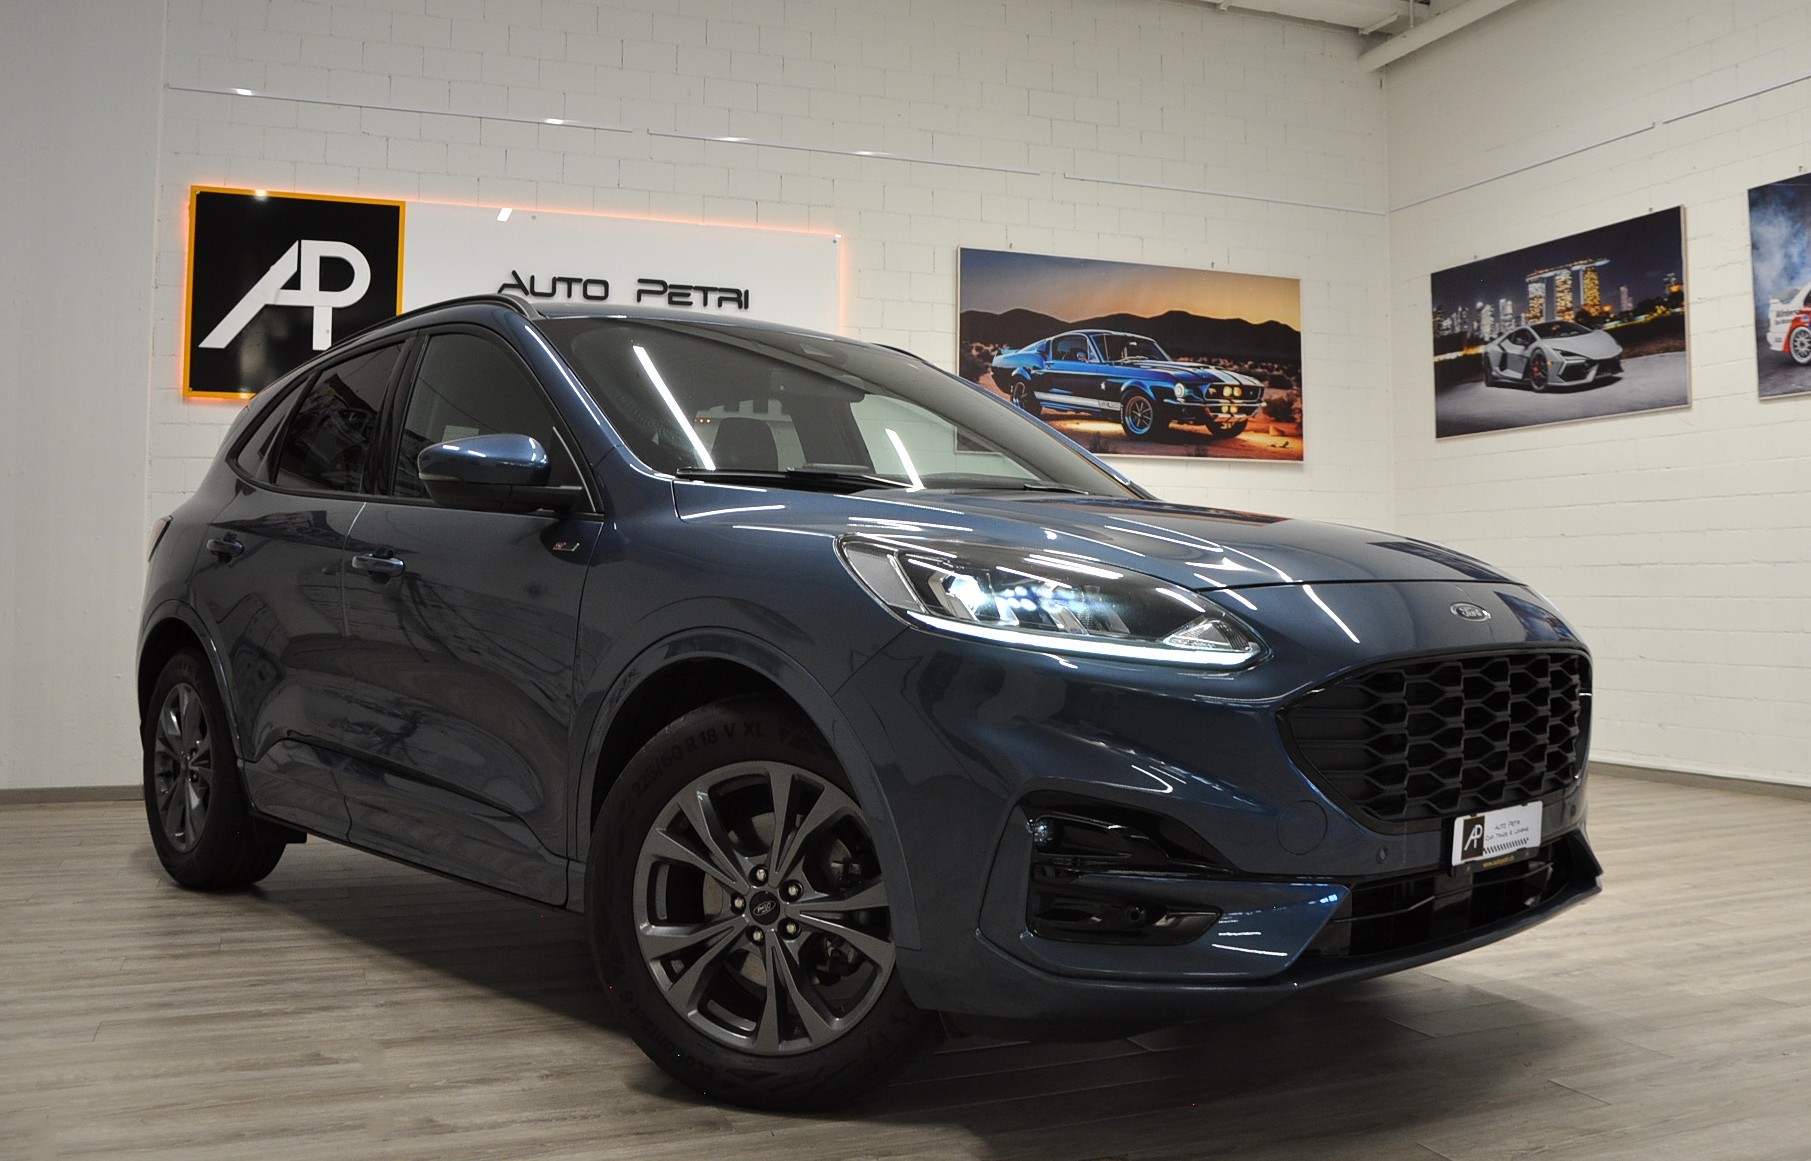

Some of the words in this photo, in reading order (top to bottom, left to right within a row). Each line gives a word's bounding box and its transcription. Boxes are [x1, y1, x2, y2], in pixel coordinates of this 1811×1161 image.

[497, 269, 610, 301] AUTO
[636, 277, 750, 310] PETRI
[631, 744, 684, 798] 225/60
[723, 722, 736, 739] V
[743, 721, 766, 738] XL
